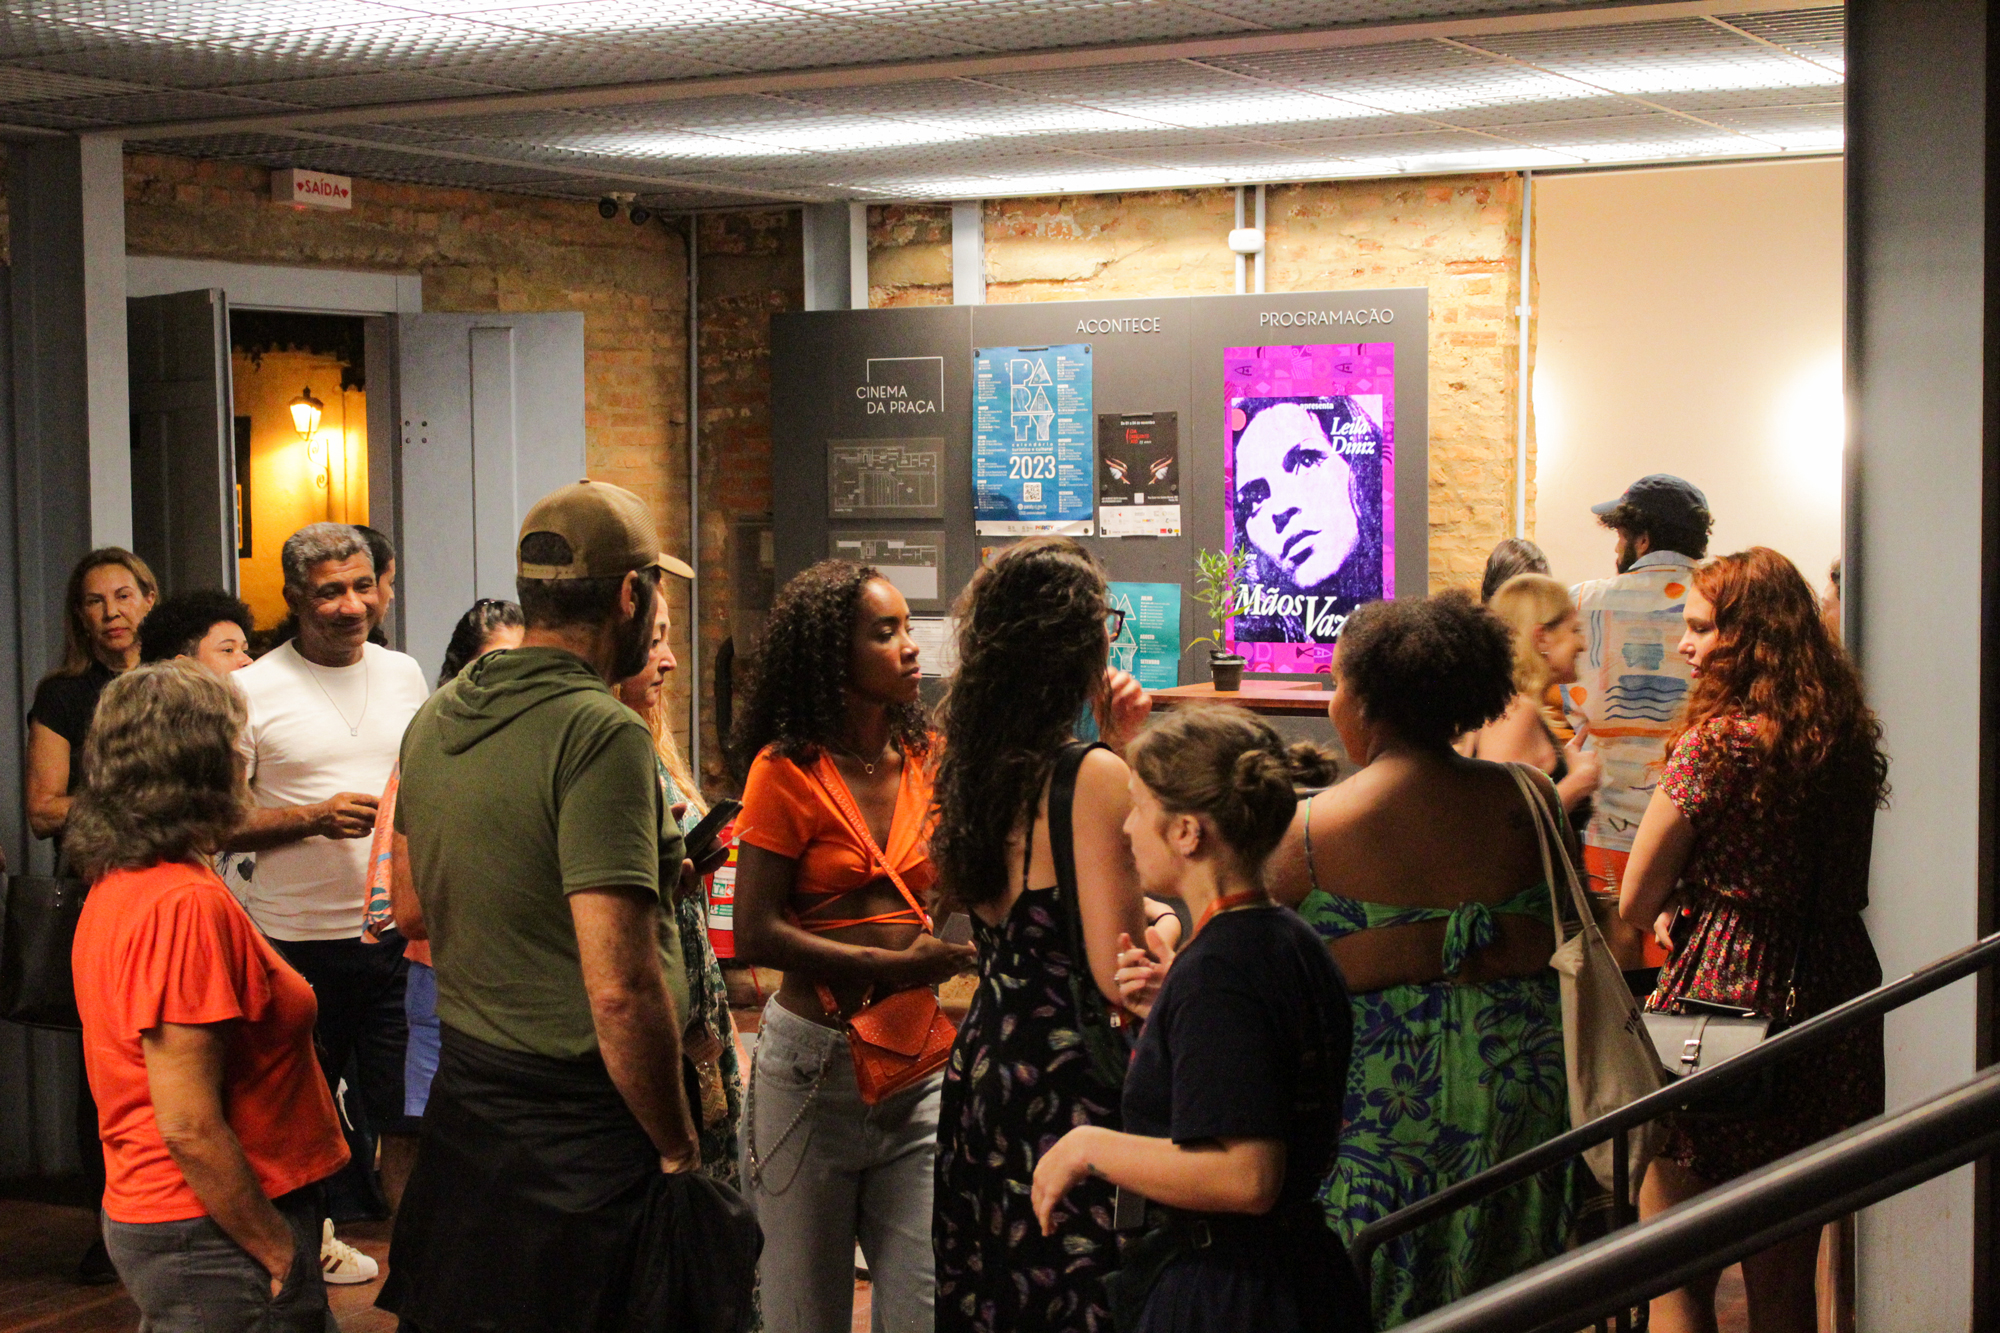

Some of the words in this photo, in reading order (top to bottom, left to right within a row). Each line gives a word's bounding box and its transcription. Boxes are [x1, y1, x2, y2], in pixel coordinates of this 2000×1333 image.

[305, 178, 341, 198] SAÍDA
[1075, 317, 1162, 334] ACONTECE
[1259, 308, 1395, 327] PROGRAMAÇÃO
[856, 385, 908, 399] CINEMA
[867, 401, 886, 414] DA
[890, 400, 936, 414] PRAÇA
[1330, 417, 1367, 436] Leila
[1331, 436, 1376, 455] Diniz
[1009, 455, 1056, 479] 2023
[1234, 583, 1306, 617] Mãos
